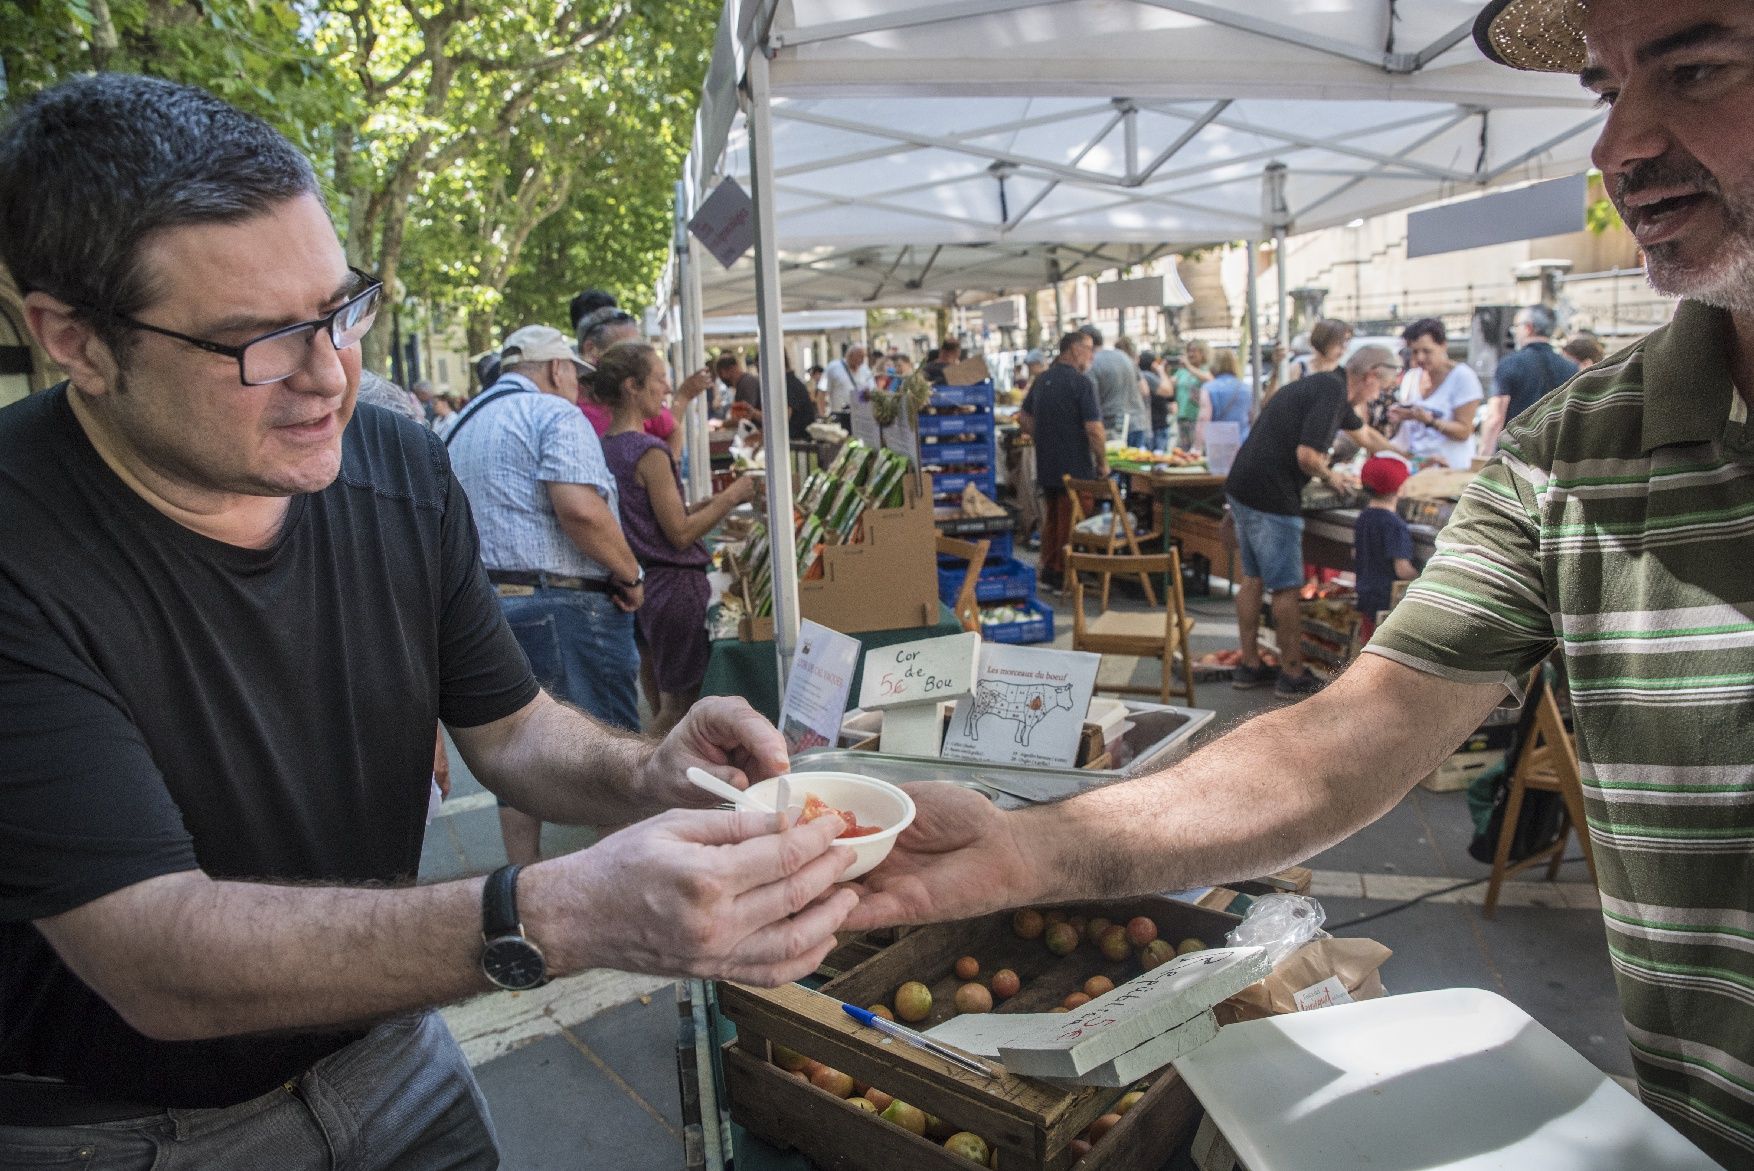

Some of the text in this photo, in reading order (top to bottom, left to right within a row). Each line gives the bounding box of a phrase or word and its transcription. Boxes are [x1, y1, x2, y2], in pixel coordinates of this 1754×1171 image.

[895, 650, 921, 663] Cor
[904, 664, 926, 678] de
[986, 665, 999, 674] Les
[1000, 667, 1034, 678] morceaux
[1034, 669, 1046, 679] du
[924, 675, 953, 693] Bou
